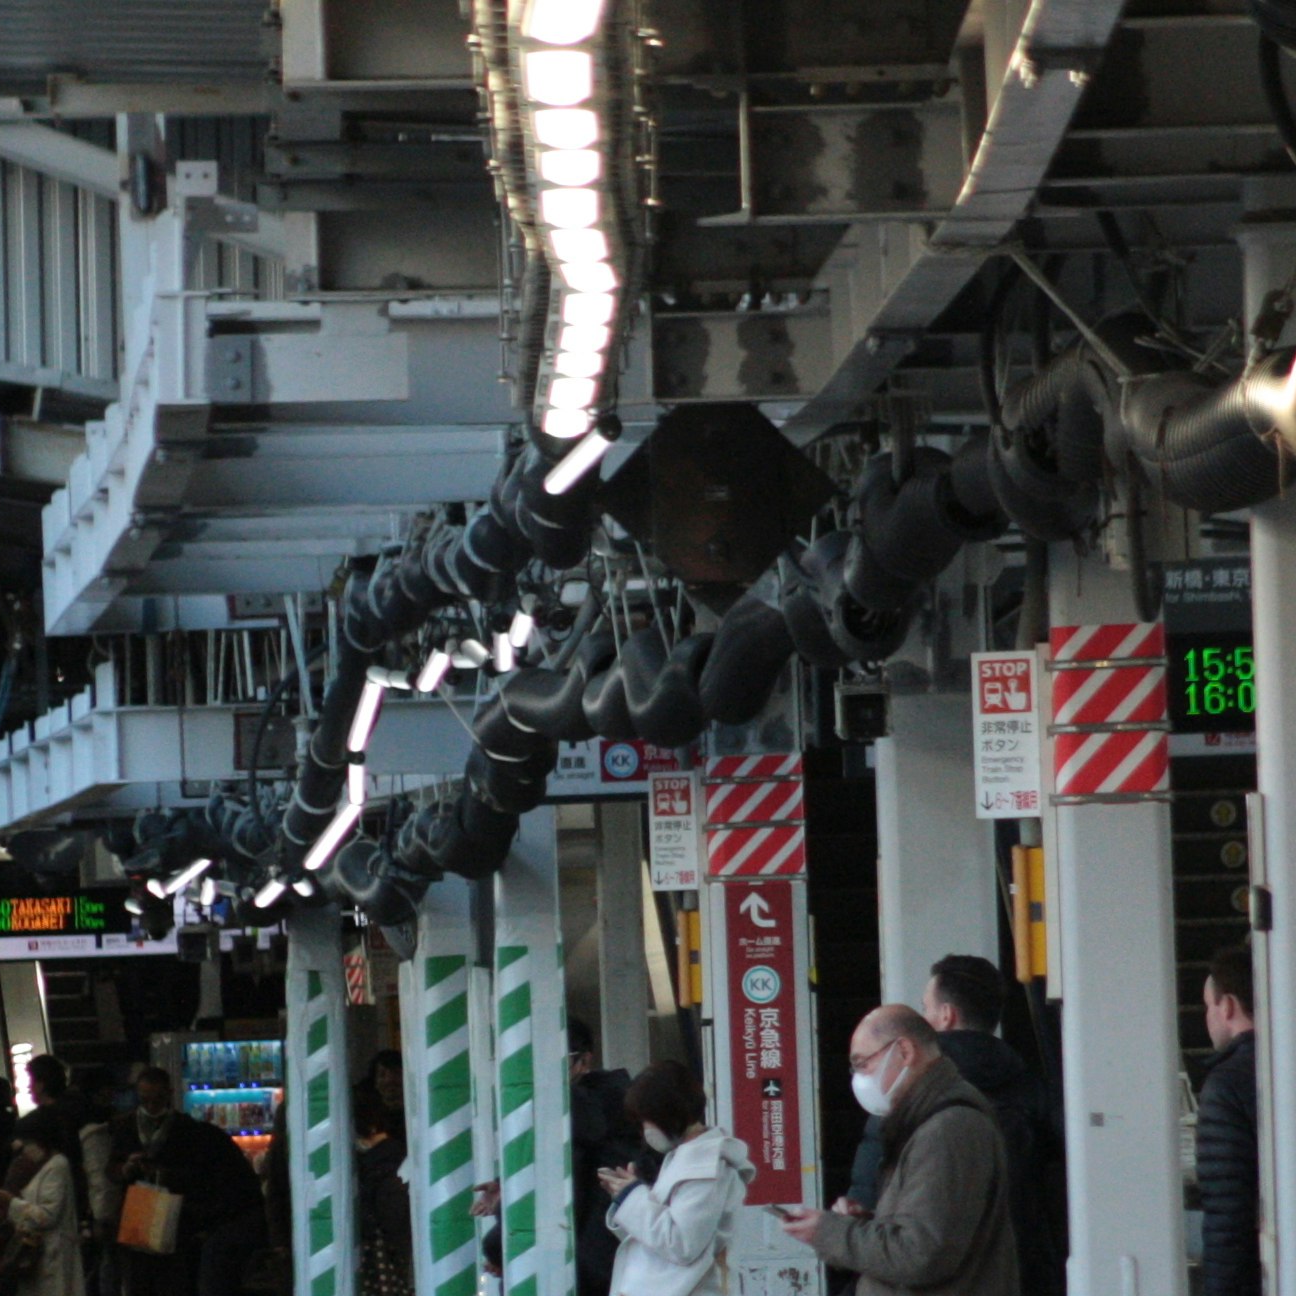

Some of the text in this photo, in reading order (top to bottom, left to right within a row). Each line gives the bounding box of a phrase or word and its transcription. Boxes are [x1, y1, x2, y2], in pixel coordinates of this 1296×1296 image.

[981, 662, 1028, 678] STOP
[1184, 646, 1256, 681] 15:5
[1185, 681, 1257, 715] 16:0
[981, 720, 1032, 735] 非常停止
[981, 740, 1019, 752] ボタン
[611, 754, 631, 767] KK
[655, 779, 689, 790] STOP
[12, 897, 72, 915] TAKASAKI
[11, 914, 64, 931] KOGANEI
[750, 977, 773, 991] KK
[759, 1007, 782, 1069] 京急線
[745, 1052, 757, 1079] Line
[770, 1100, 785, 1171] 羽田空港方面
